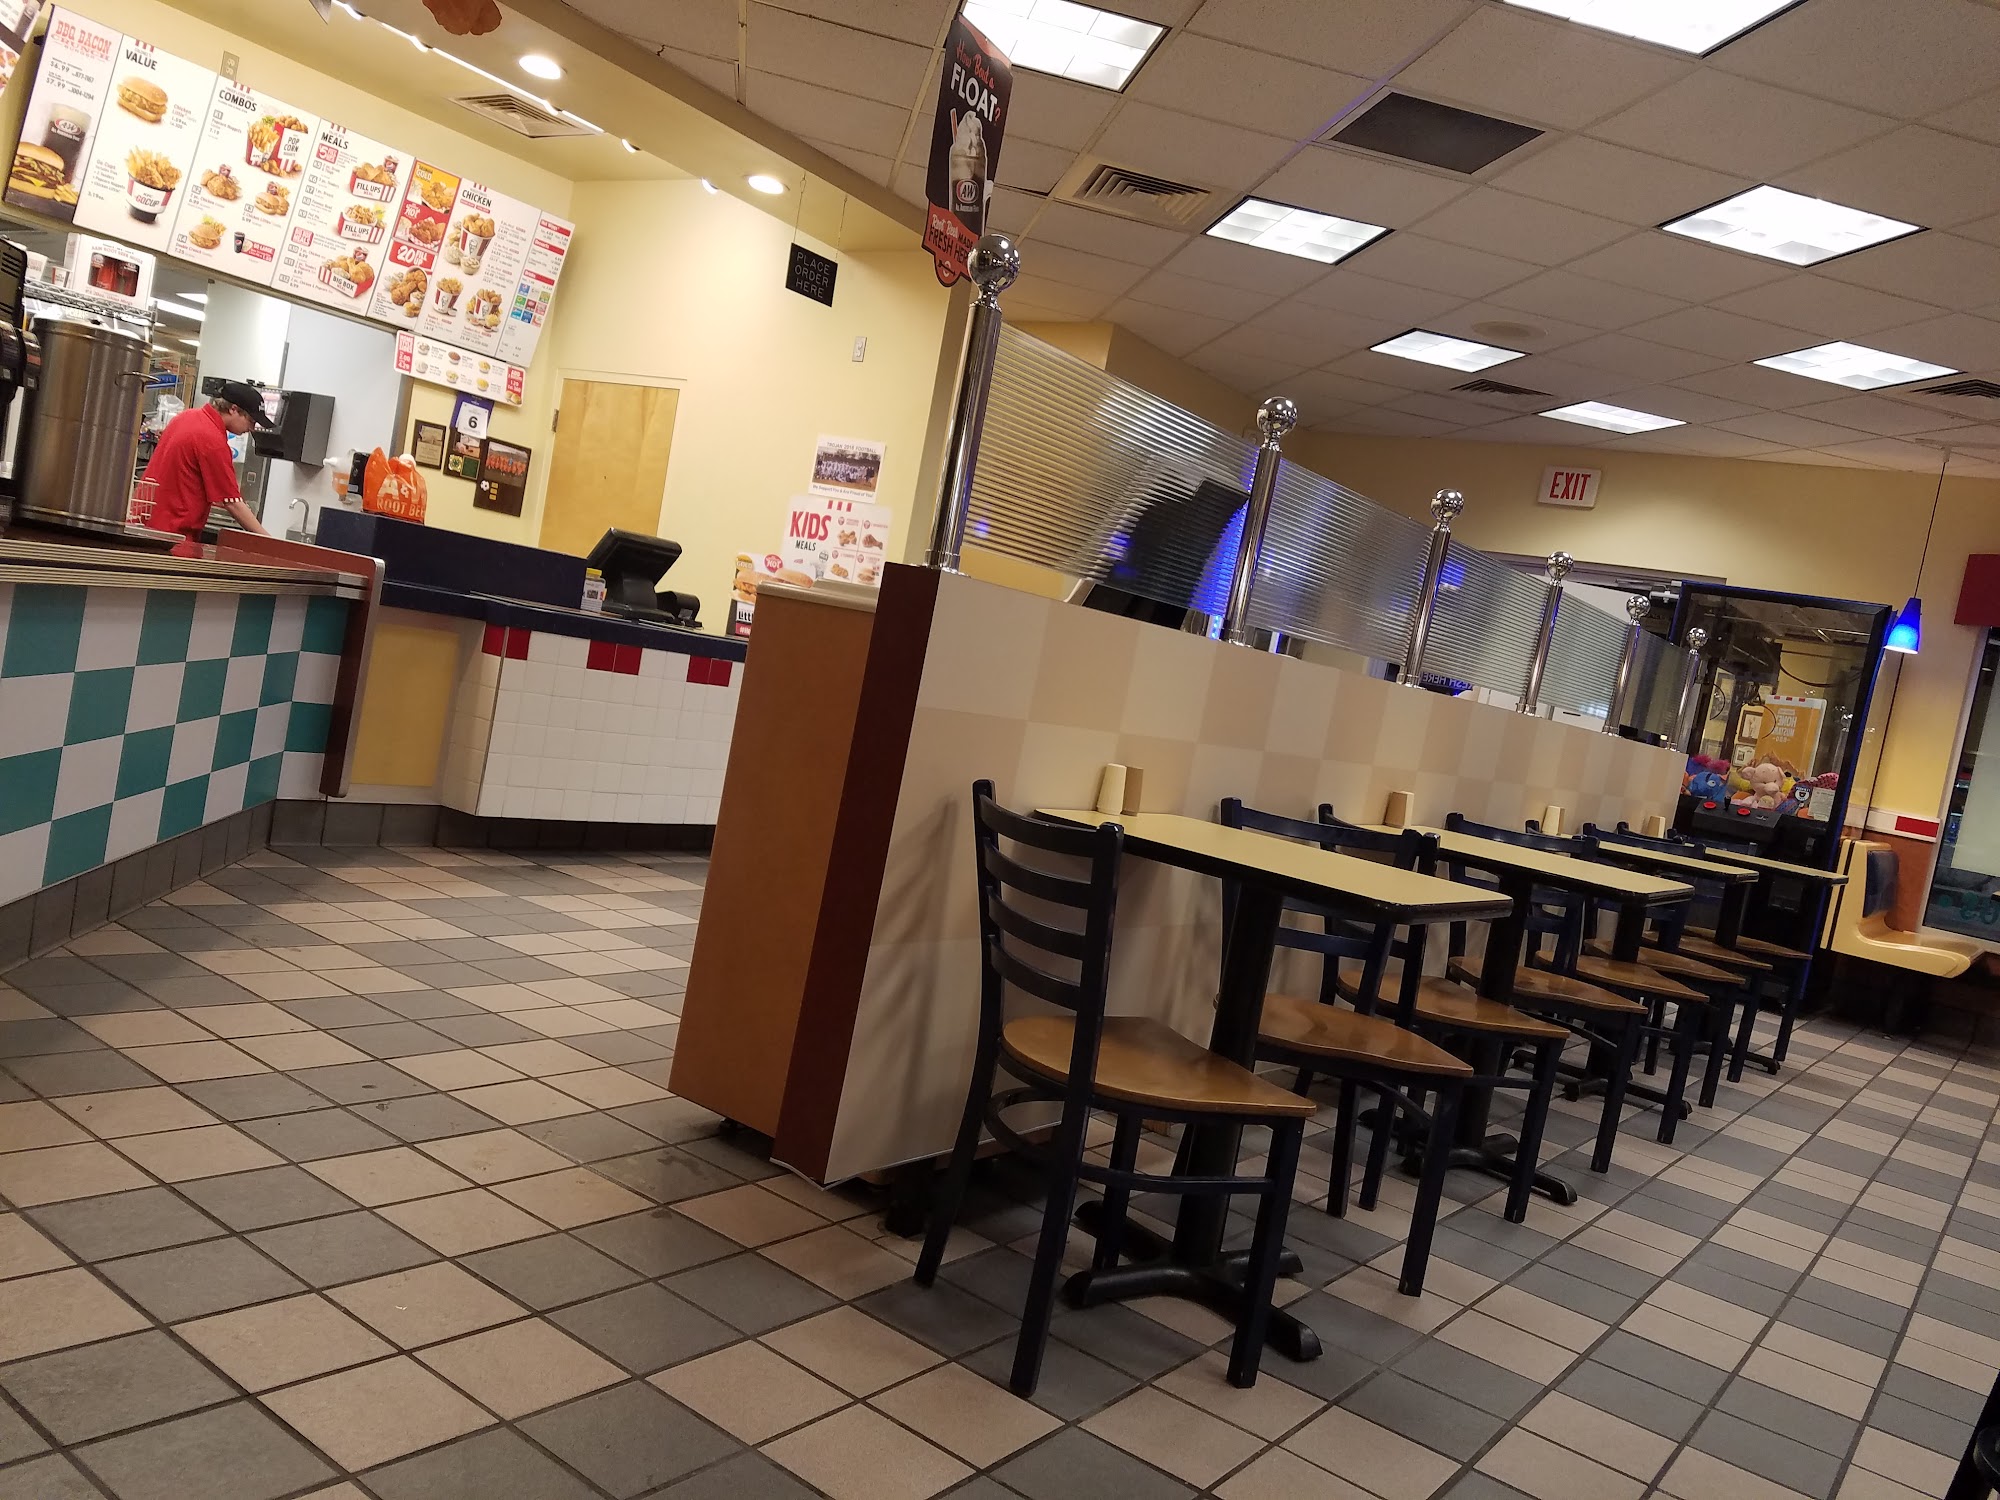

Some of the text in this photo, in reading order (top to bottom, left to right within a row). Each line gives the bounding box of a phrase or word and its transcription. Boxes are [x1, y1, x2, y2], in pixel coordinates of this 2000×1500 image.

[50, 32, 110, 61] CRUNCH
[54, 20, 111, 55] BBQ BACON
[124, 49, 157, 70] VALUE
[956, 38, 972, 68] How
[218, 88, 258, 112] COMBOS
[283, 141, 298, 154] CORN
[287, 135, 300, 146] POP
[320, 131, 349, 150] MEALS
[414, 168, 432, 181] GOLD
[356, 180, 381, 194] FILL UPS
[461, 188, 492, 207] CHICKEN
[344, 222, 370, 236] FILL UPS
[932, 214, 946, 232] Root
[929, 224, 954, 257] FRESH
[413, 256, 423, 266] UP
[415, 250, 428, 260] FILL
[796, 252, 830, 276] PLACE
[332, 275, 355, 291] BIG BOX
[794, 264, 828, 288] ORDER
[796, 278, 824, 298] HERE
[468, 416, 478, 428] 6
[1550, 472, 1592, 500] EXIT
[377, 496, 408, 514] ROOT
[790, 511, 832, 542] KIDS
[795, 540, 816, 552] MEALS
[736, 560, 782, 569] GOLD HOT
